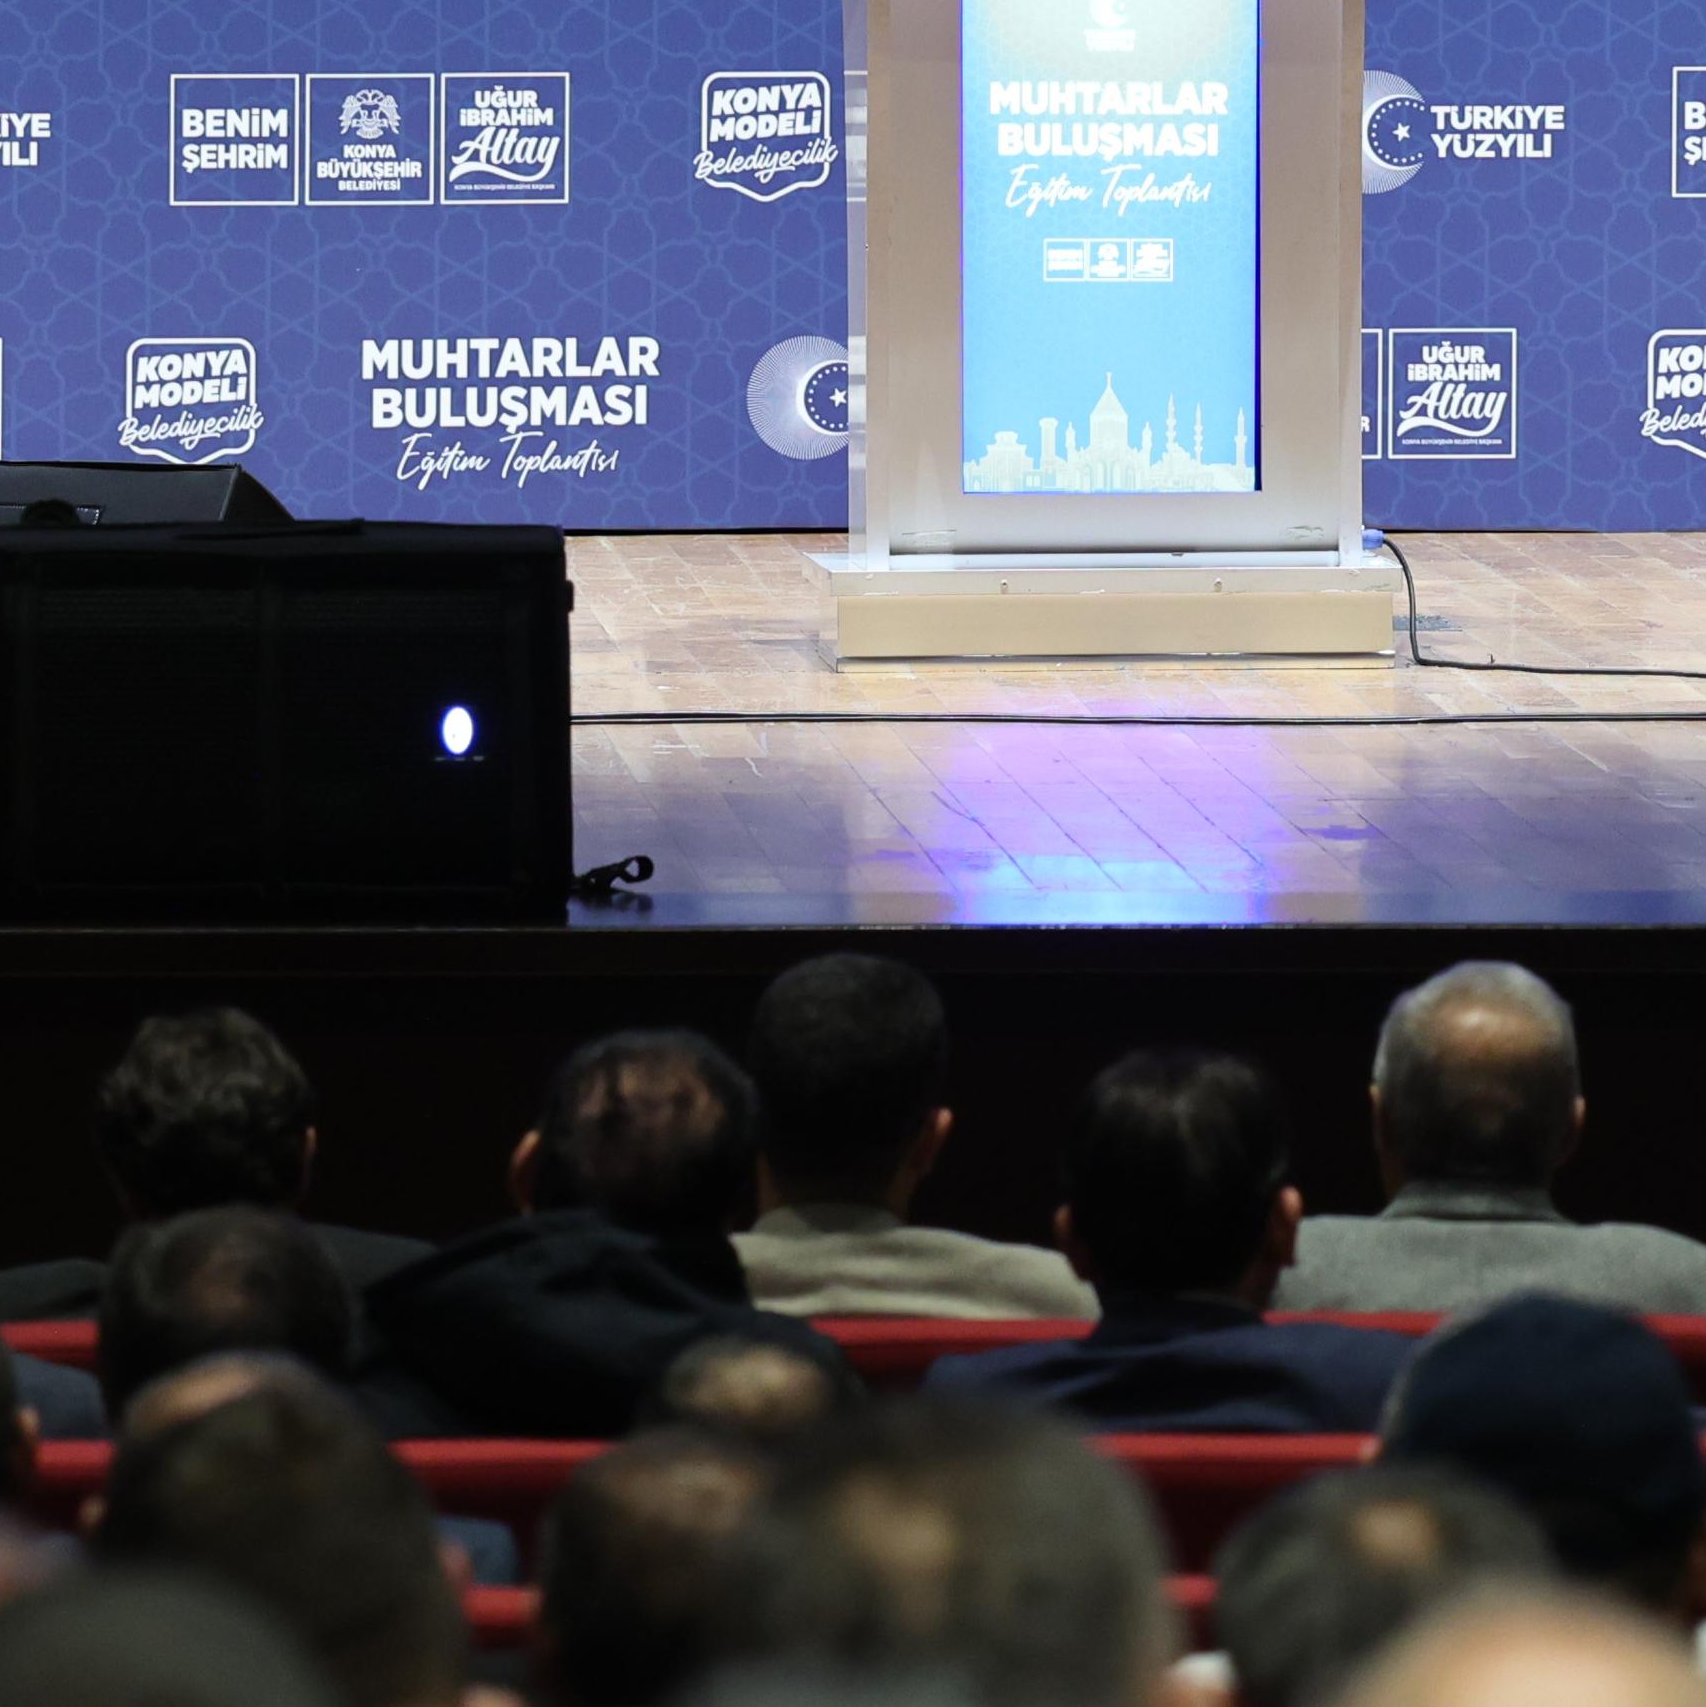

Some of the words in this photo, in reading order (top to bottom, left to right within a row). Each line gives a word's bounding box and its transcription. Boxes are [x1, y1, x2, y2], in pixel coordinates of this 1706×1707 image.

[474, 86, 538, 109] UĞUR
[989, 79, 1229, 116] MUHTARLAR
[182, 107, 288, 137] BENİM
[182, 142, 288, 173] ŞEHRİM
[344, 144, 397, 159] KONYA
[449, 127, 561, 184] Altay
[997, 122, 1219, 162] BULUŞMASI
[316, 158, 423, 181] BÜYÜKŞEHİR
[338, 178, 402, 191] BELEDİYESİ
[1005, 163, 1092, 217] Eğitim
[362, 338, 659, 379] MUHTARLAR
[1422, 341, 1485, 363] UĞUR
[372, 387, 647, 435] BULUŞMASI
[1397, 381, 1507, 437] Altay
[398, 431, 491, 490] Eğitim
[499, 431, 620, 489] Toplantısı
